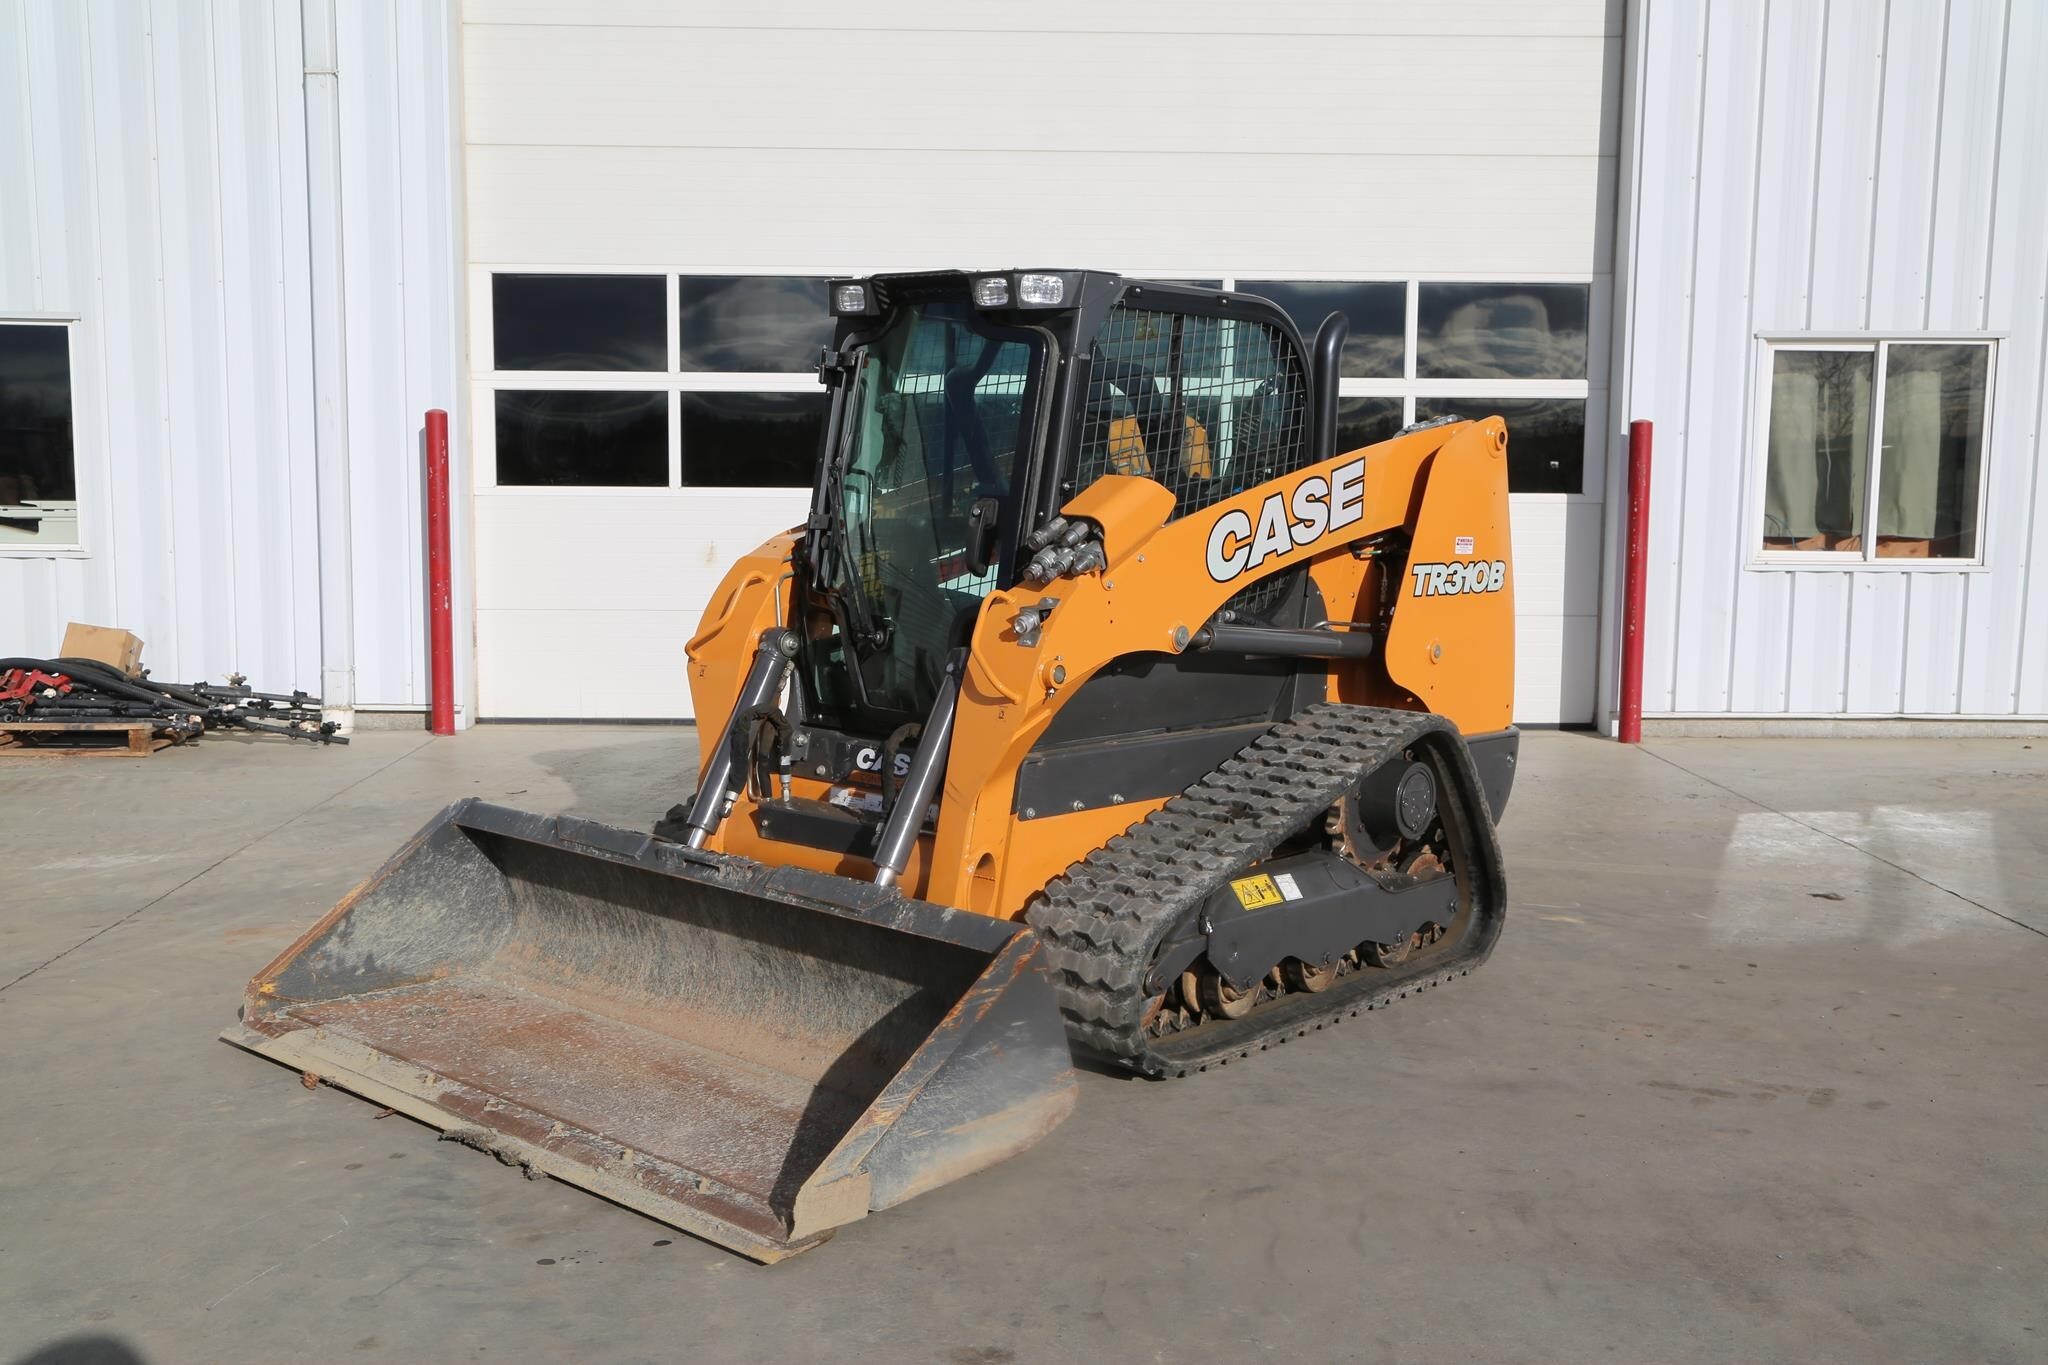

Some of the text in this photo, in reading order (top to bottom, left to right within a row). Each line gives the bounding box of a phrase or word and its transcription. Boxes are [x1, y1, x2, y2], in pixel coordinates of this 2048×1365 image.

[1206, 456, 1366, 583] CASE
[1412, 560, 1506, 597] TR310B
[857, 748, 911, 775] CS
